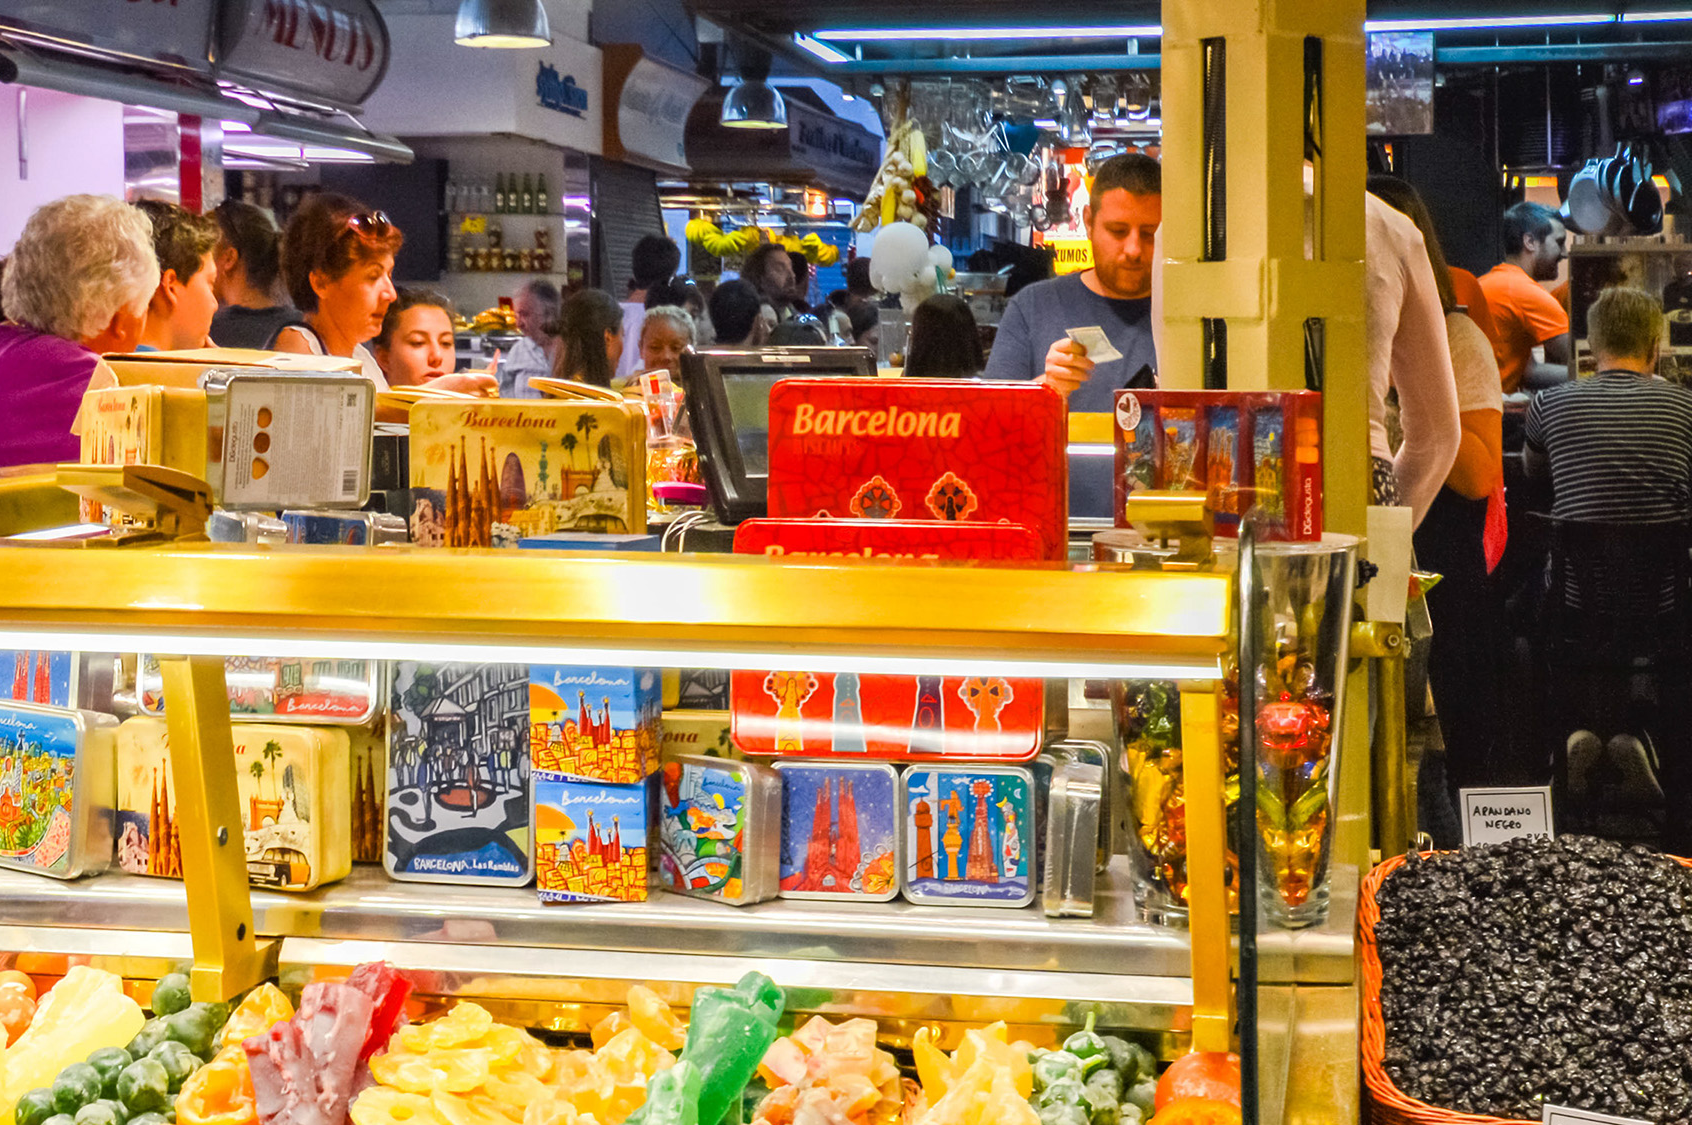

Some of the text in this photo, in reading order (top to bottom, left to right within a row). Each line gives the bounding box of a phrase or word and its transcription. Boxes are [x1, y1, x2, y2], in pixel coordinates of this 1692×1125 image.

[459, 410, 557, 428] Barcelona
[793, 403, 961, 438] Barcelona
[1485, 819, 1522, 830] NEGRO
